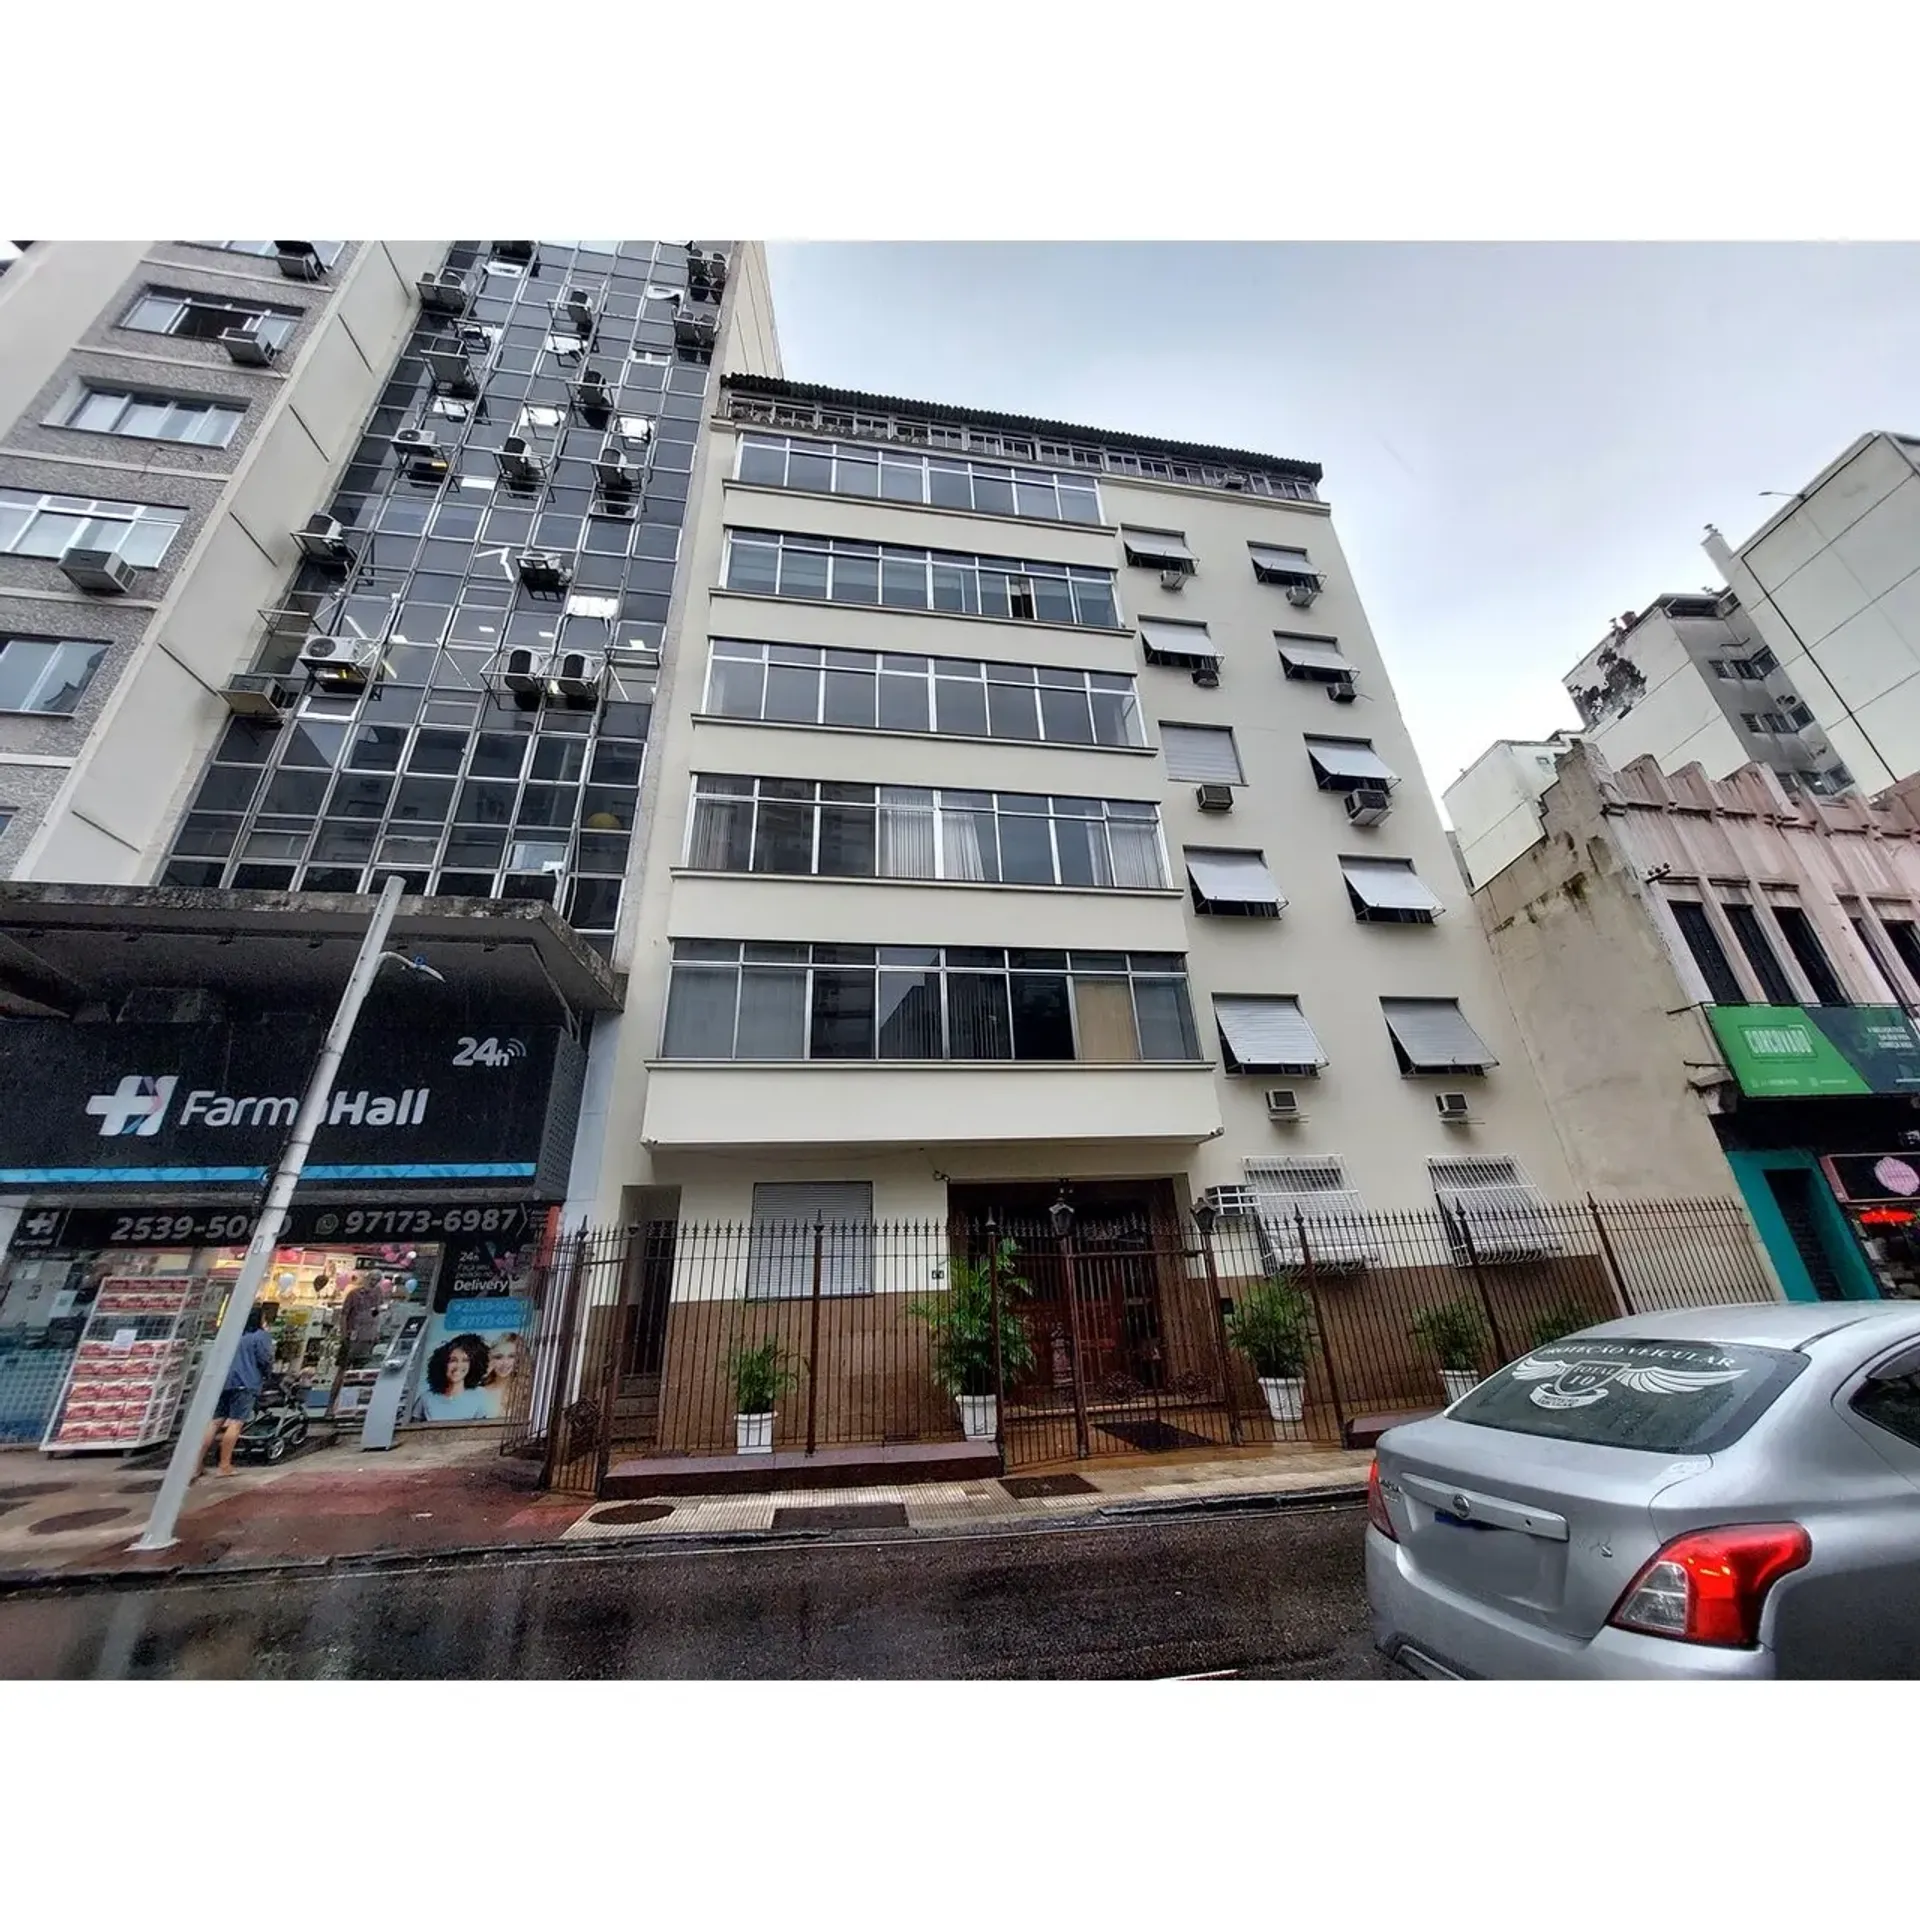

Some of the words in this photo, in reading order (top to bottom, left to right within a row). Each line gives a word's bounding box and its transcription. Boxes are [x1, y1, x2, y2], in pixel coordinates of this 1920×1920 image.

[452, 1037, 510, 1067] 24h
[344, 1208, 518, 1234] 97173-6987
[453, 1278, 509, 1293] Delivery
